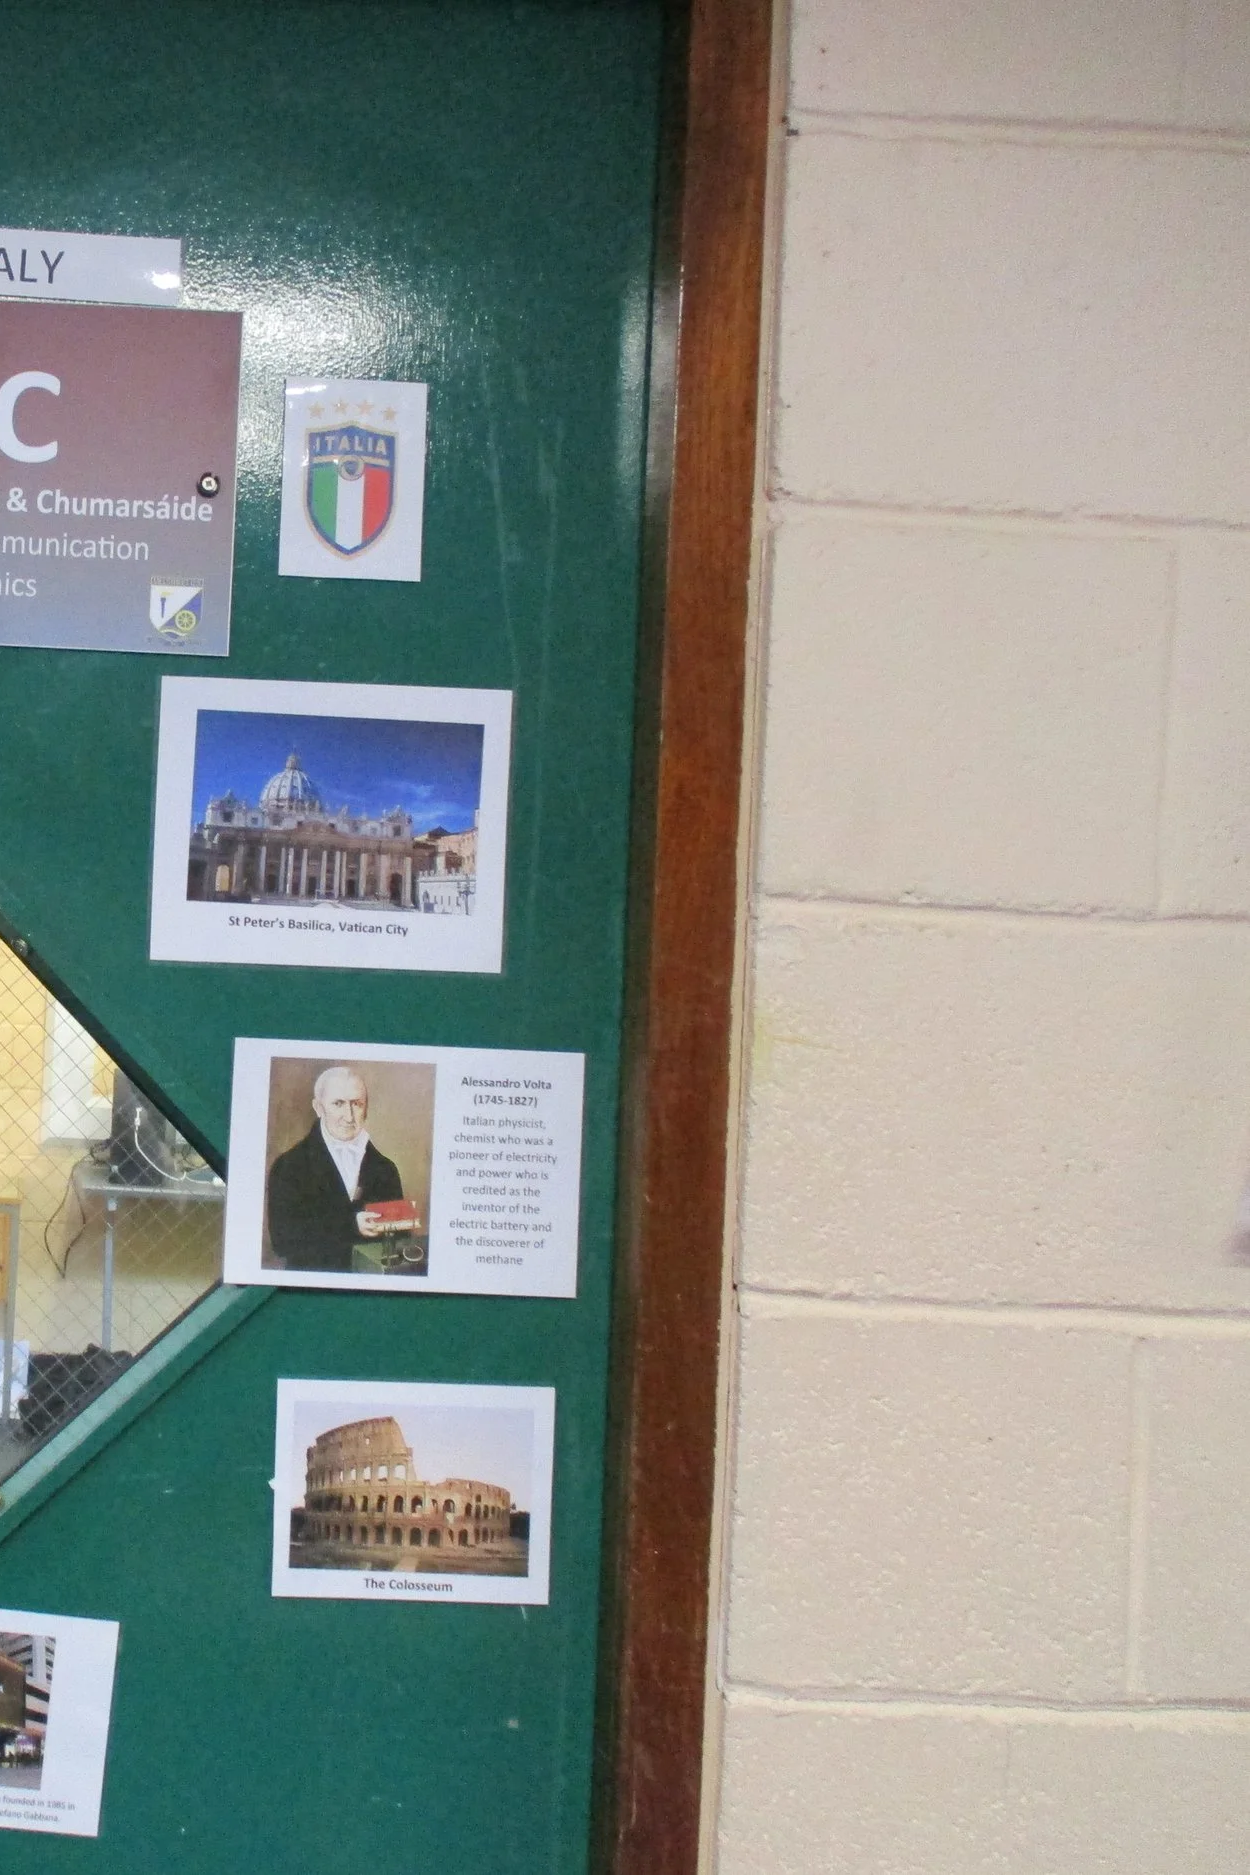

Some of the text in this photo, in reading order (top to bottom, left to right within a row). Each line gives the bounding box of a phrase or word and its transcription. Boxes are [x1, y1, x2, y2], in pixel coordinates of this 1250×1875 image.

[315, 435, 387, 455] ITALIA
[6, 487, 28, 513] &
[37, 489, 213, 522] Chumarsáide
[229, 916, 409, 937] St Peter's Basilica, Vatican City
[461, 1076, 552, 1090] Alessandro Volta
[473, 1094, 538, 1108] (1745-1827)
[463, 1115, 546, 1130] Italian physicist,
[454, 1132, 553, 1146] chemist who was a
[449, 1150, 558, 1165] pioneer of electricity
[456, 1168, 549, 1180] and power who is
[462, 1184, 541, 1197] credited as the
[462, 1201, 540, 1214] inventor of the
[449, 1218, 552, 1233] electric battery and
[455, 1235, 545, 1249] the discoverer of
[476, 1254, 523, 1265] methane
[364, 1578, 453, 1592] The Colosseum
